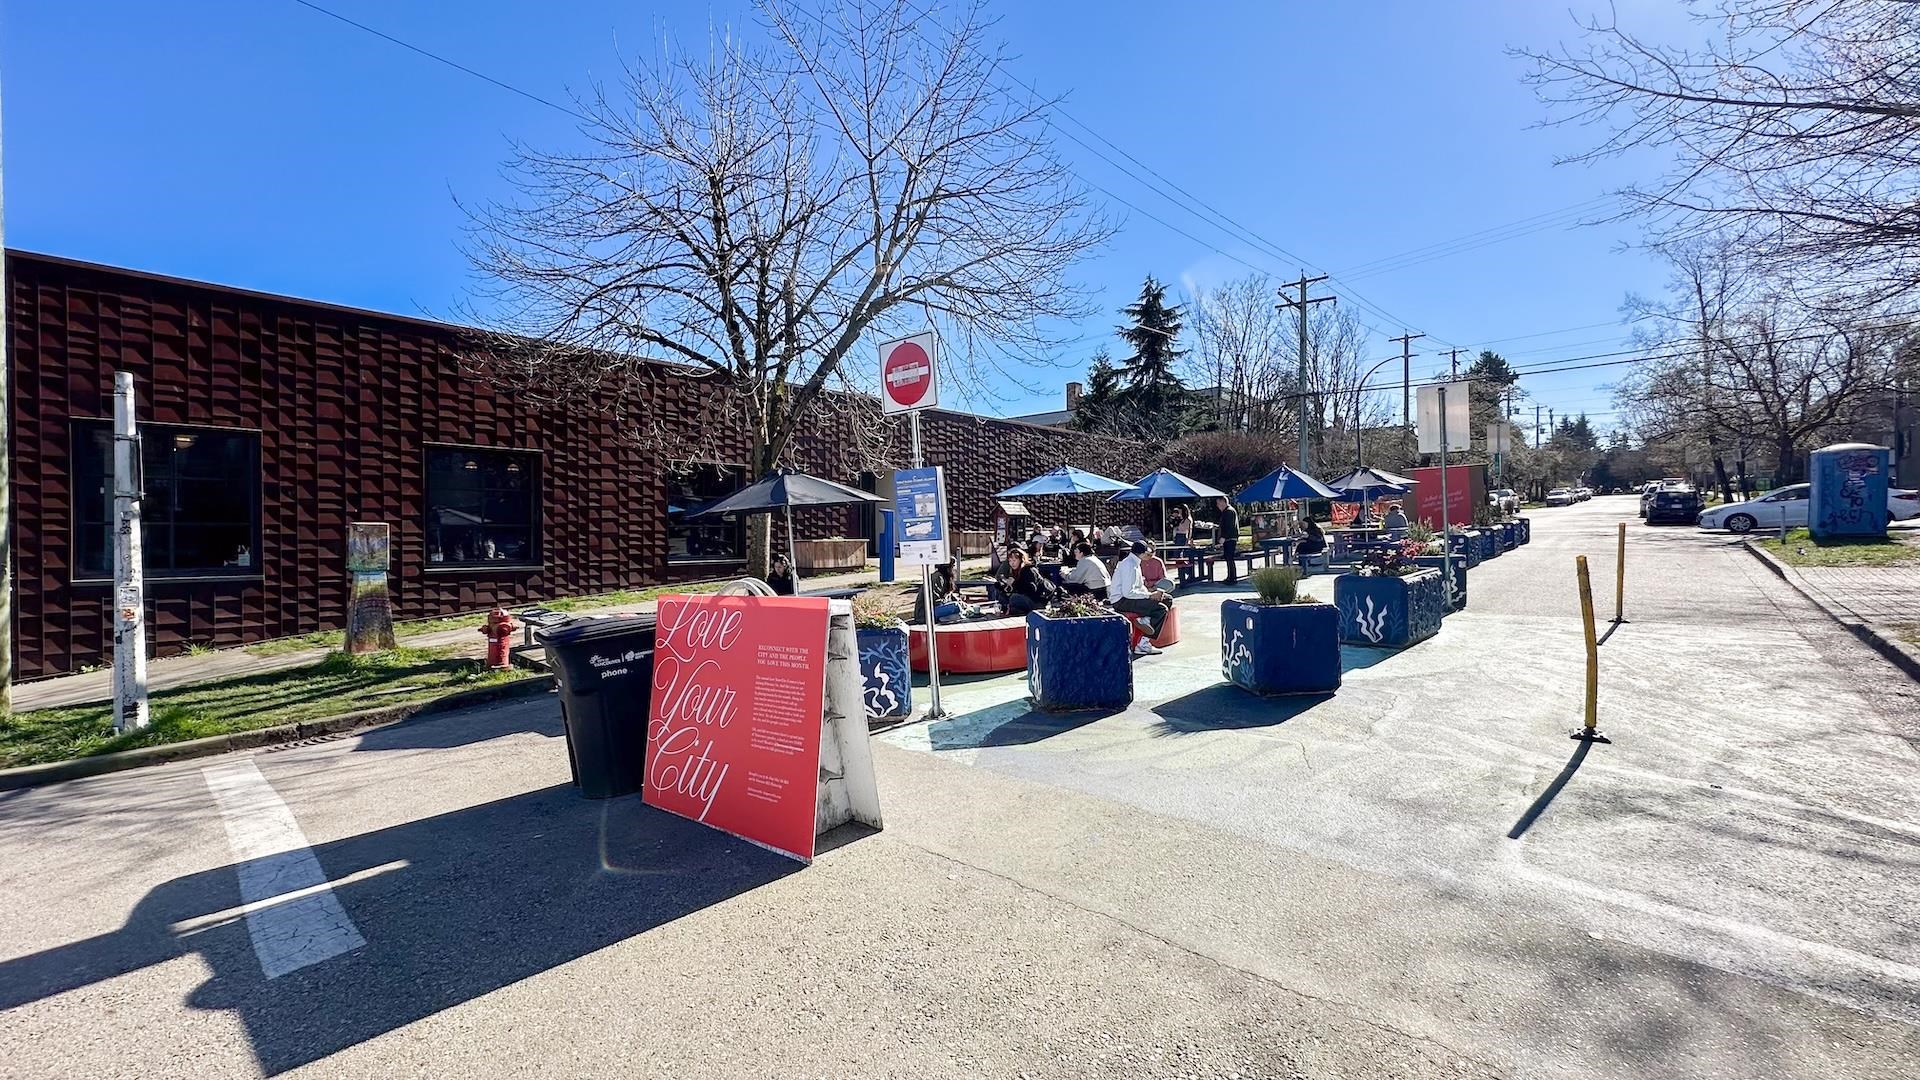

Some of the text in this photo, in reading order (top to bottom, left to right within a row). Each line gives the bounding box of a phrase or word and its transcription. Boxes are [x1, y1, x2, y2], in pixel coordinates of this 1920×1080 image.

[655, 594, 743, 662] Love
[601, 668, 628, 679] phone
[648, 657, 738, 740] Your
[650, 726, 729, 821] City
